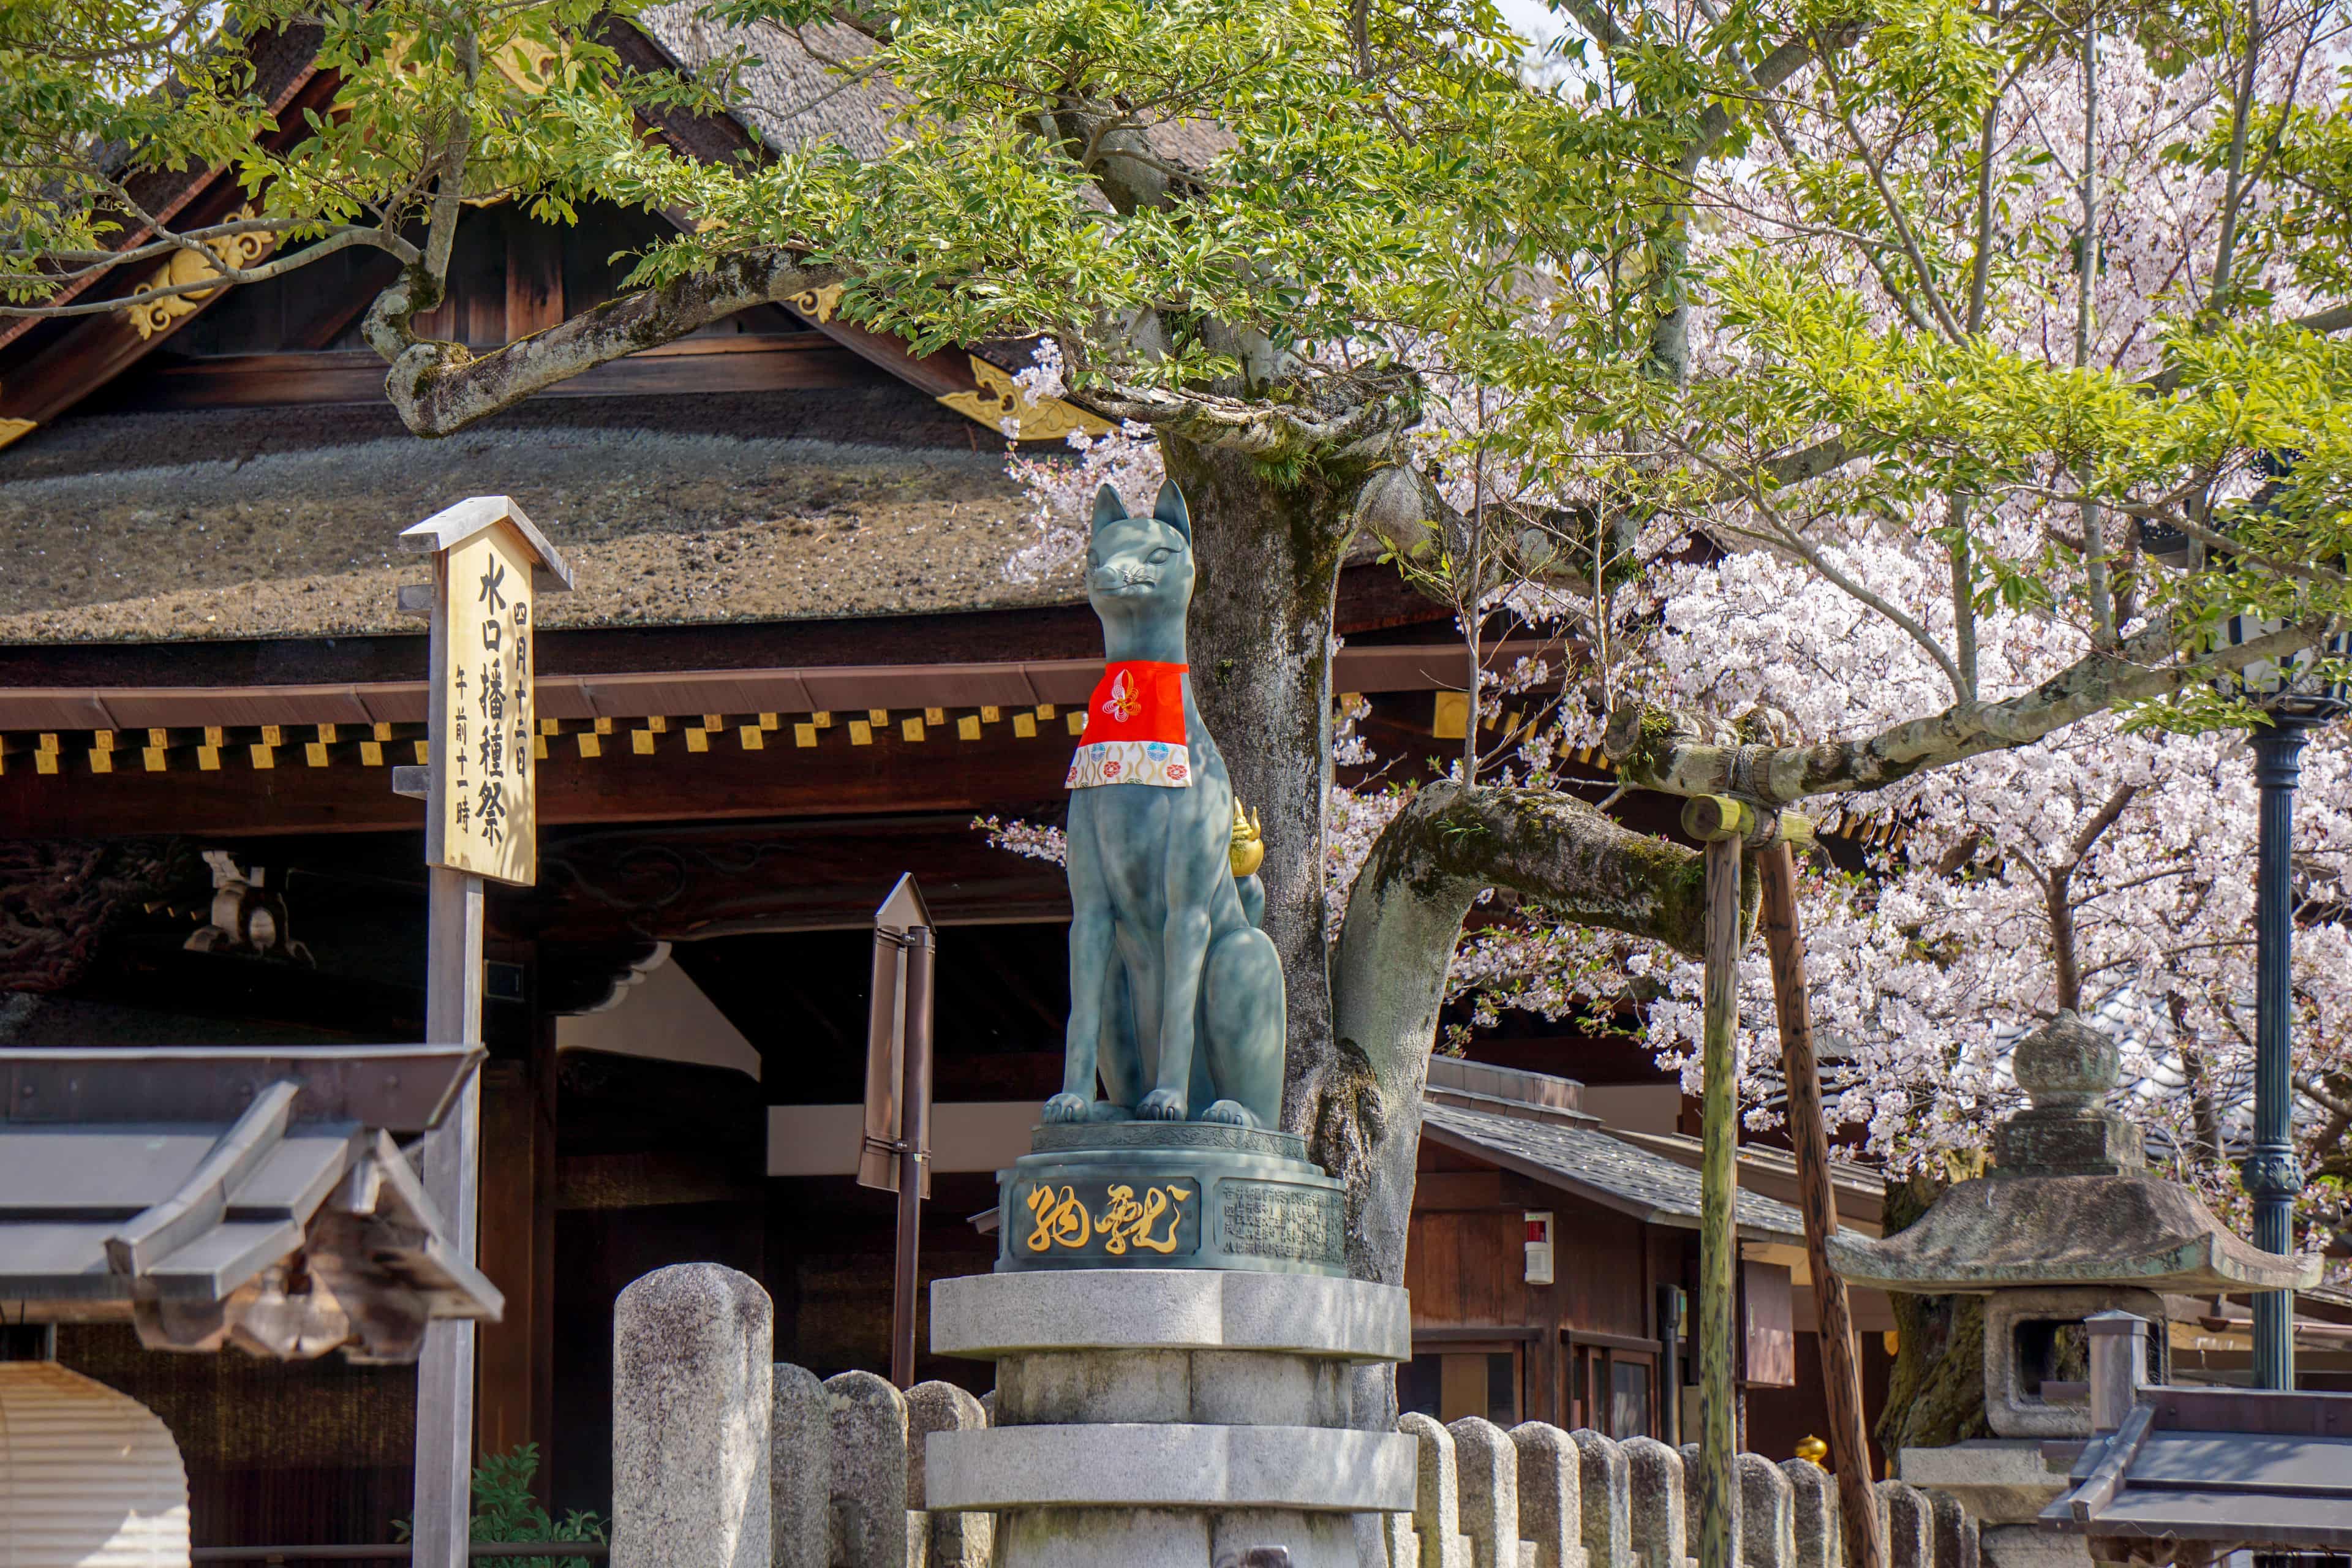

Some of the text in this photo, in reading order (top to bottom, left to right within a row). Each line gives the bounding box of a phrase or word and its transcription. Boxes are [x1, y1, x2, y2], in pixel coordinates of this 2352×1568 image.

[455, 663, 470, 834] 午前十一時
[475, 552, 507, 847] 水口播種祭
[513, 601, 527, 778] 四月十二日
